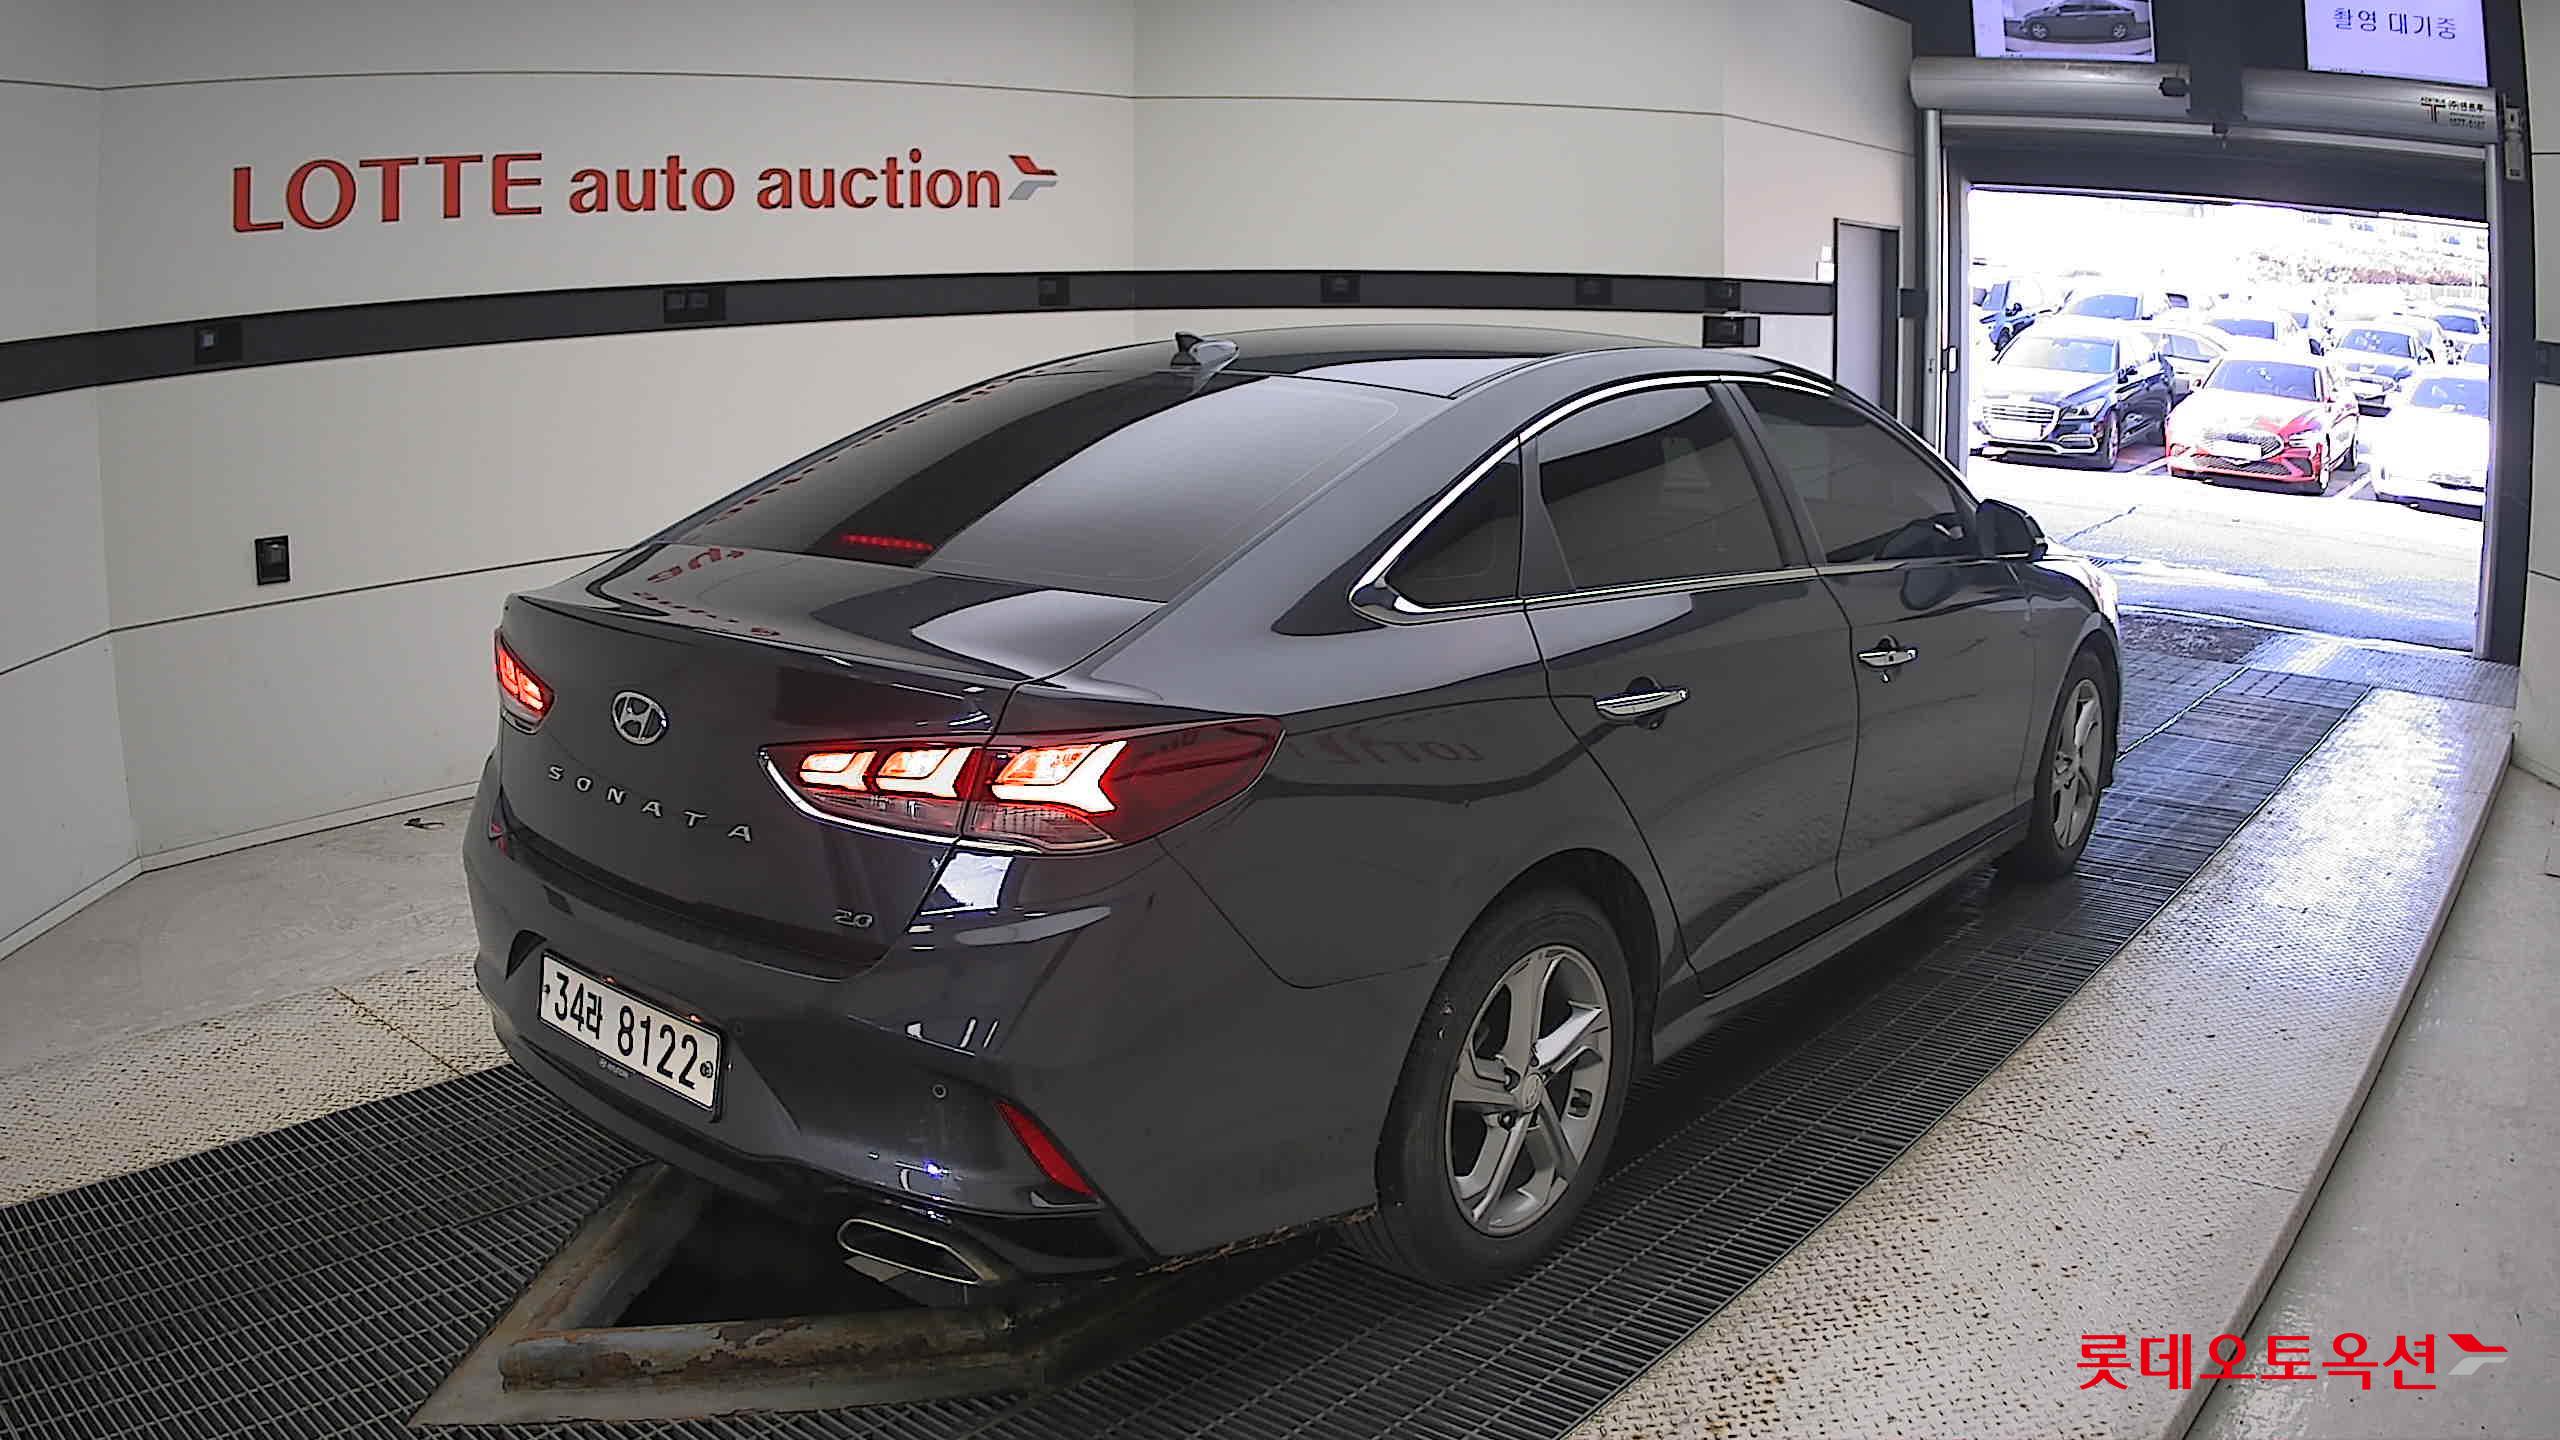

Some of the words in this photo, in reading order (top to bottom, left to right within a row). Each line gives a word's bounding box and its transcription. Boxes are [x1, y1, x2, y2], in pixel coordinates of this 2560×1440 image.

[2334, 8, 2377, 32] 촬영
[2388, 12, 2457, 40] 대기중
[235, 153, 541, 233] LOTTE
[570, 156, 736, 215] auto
[757, 150, 1002, 210] auction
[547, 765, 752, 842] SONATA
[554, 971, 604, 1040] 34라
[616, 1005, 698, 1090] 8122
